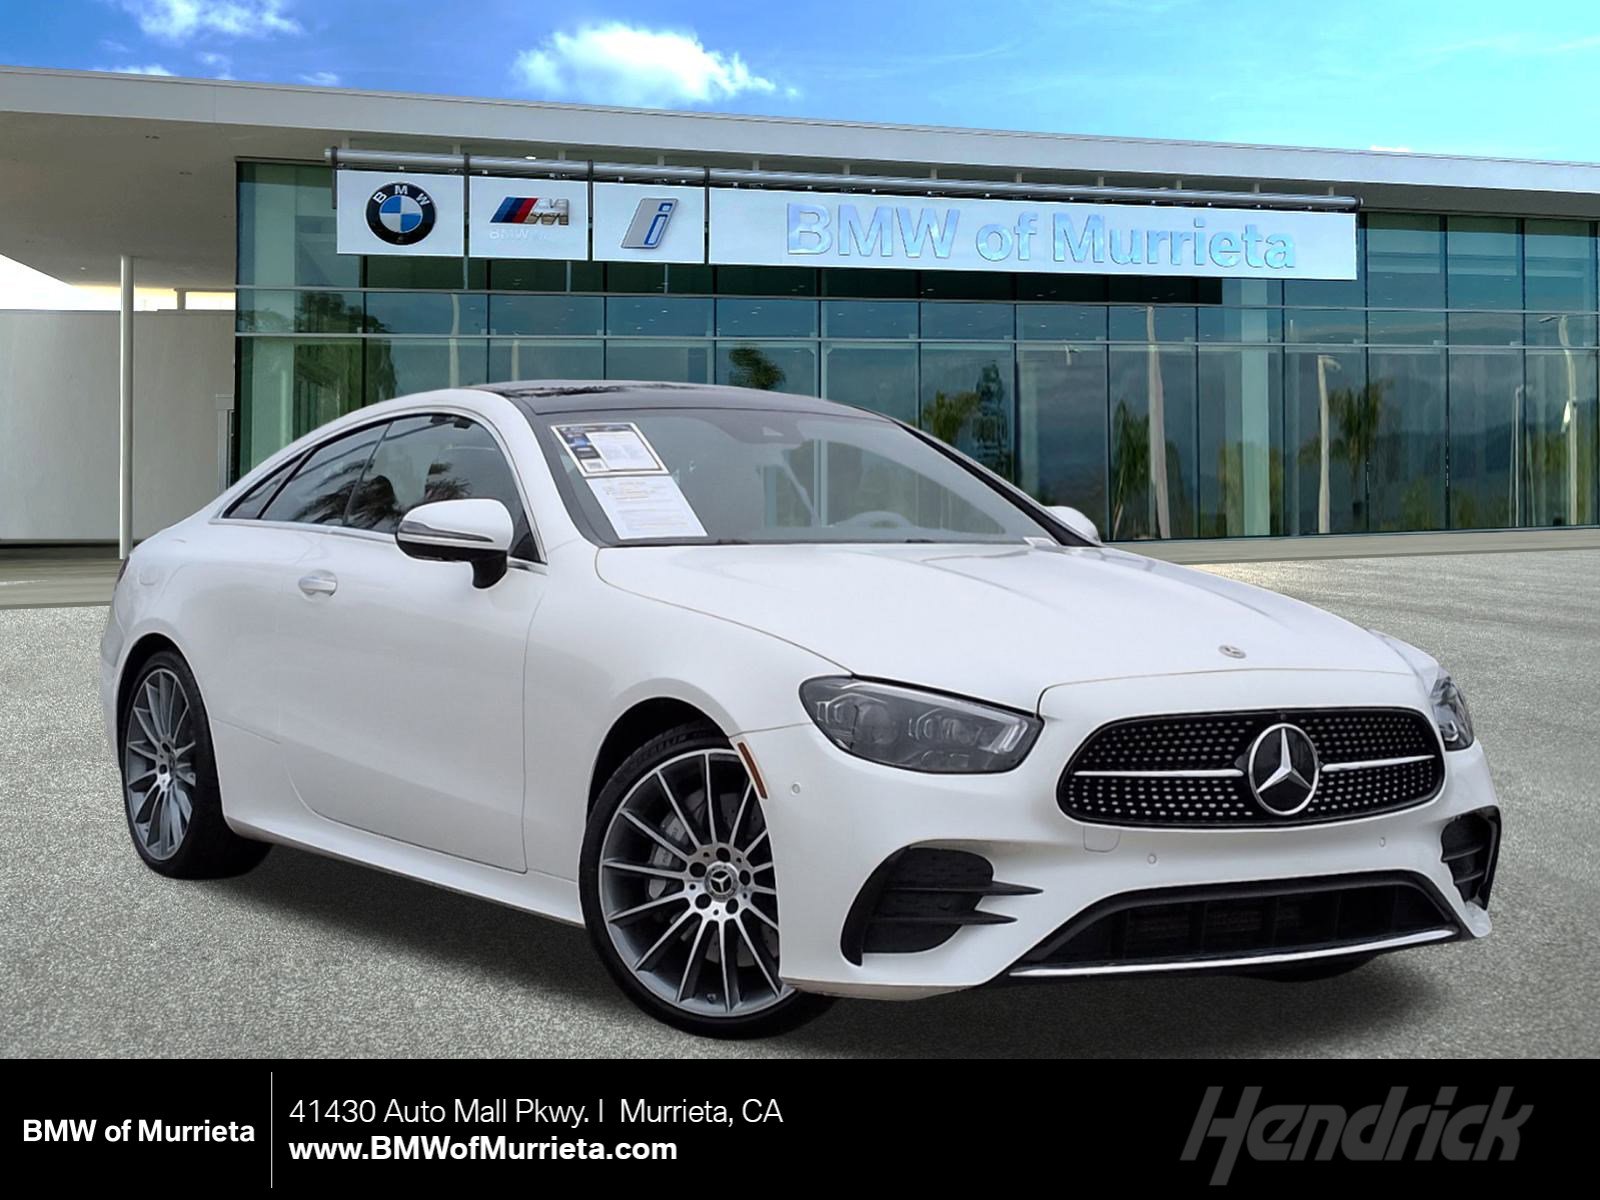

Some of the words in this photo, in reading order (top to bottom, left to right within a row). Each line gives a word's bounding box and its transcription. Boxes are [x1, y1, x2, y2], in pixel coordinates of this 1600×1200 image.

[373, 185, 430, 206] BMW
[786, 203, 961, 259] BMW
[976, 211, 1039, 262] of
[1052, 212, 1296, 269] Murrieta
